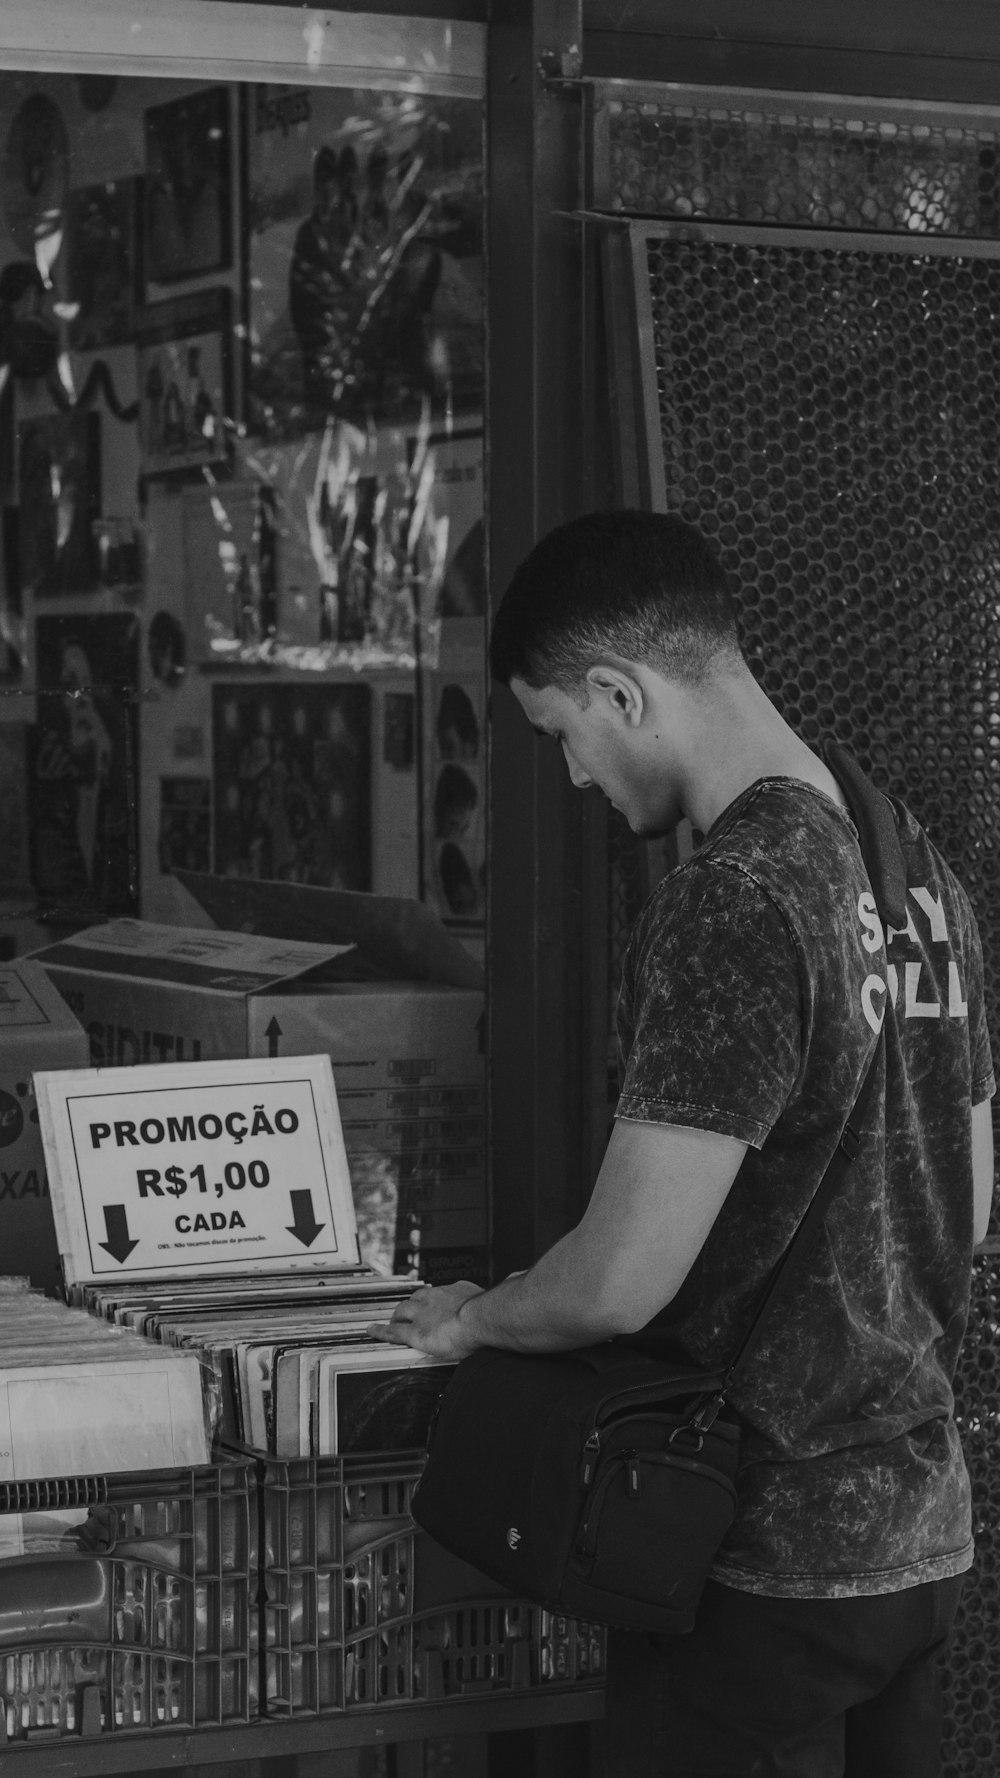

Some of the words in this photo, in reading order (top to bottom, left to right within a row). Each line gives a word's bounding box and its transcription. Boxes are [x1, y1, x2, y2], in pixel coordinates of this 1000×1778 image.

[89, 1104, 299, 1149] PROMOÇÃO
[136, 1159, 270, 1199] R$1,00
[175, 1210, 246, 1234] CADA
[429, 1255, 475, 1268] GRUPO
